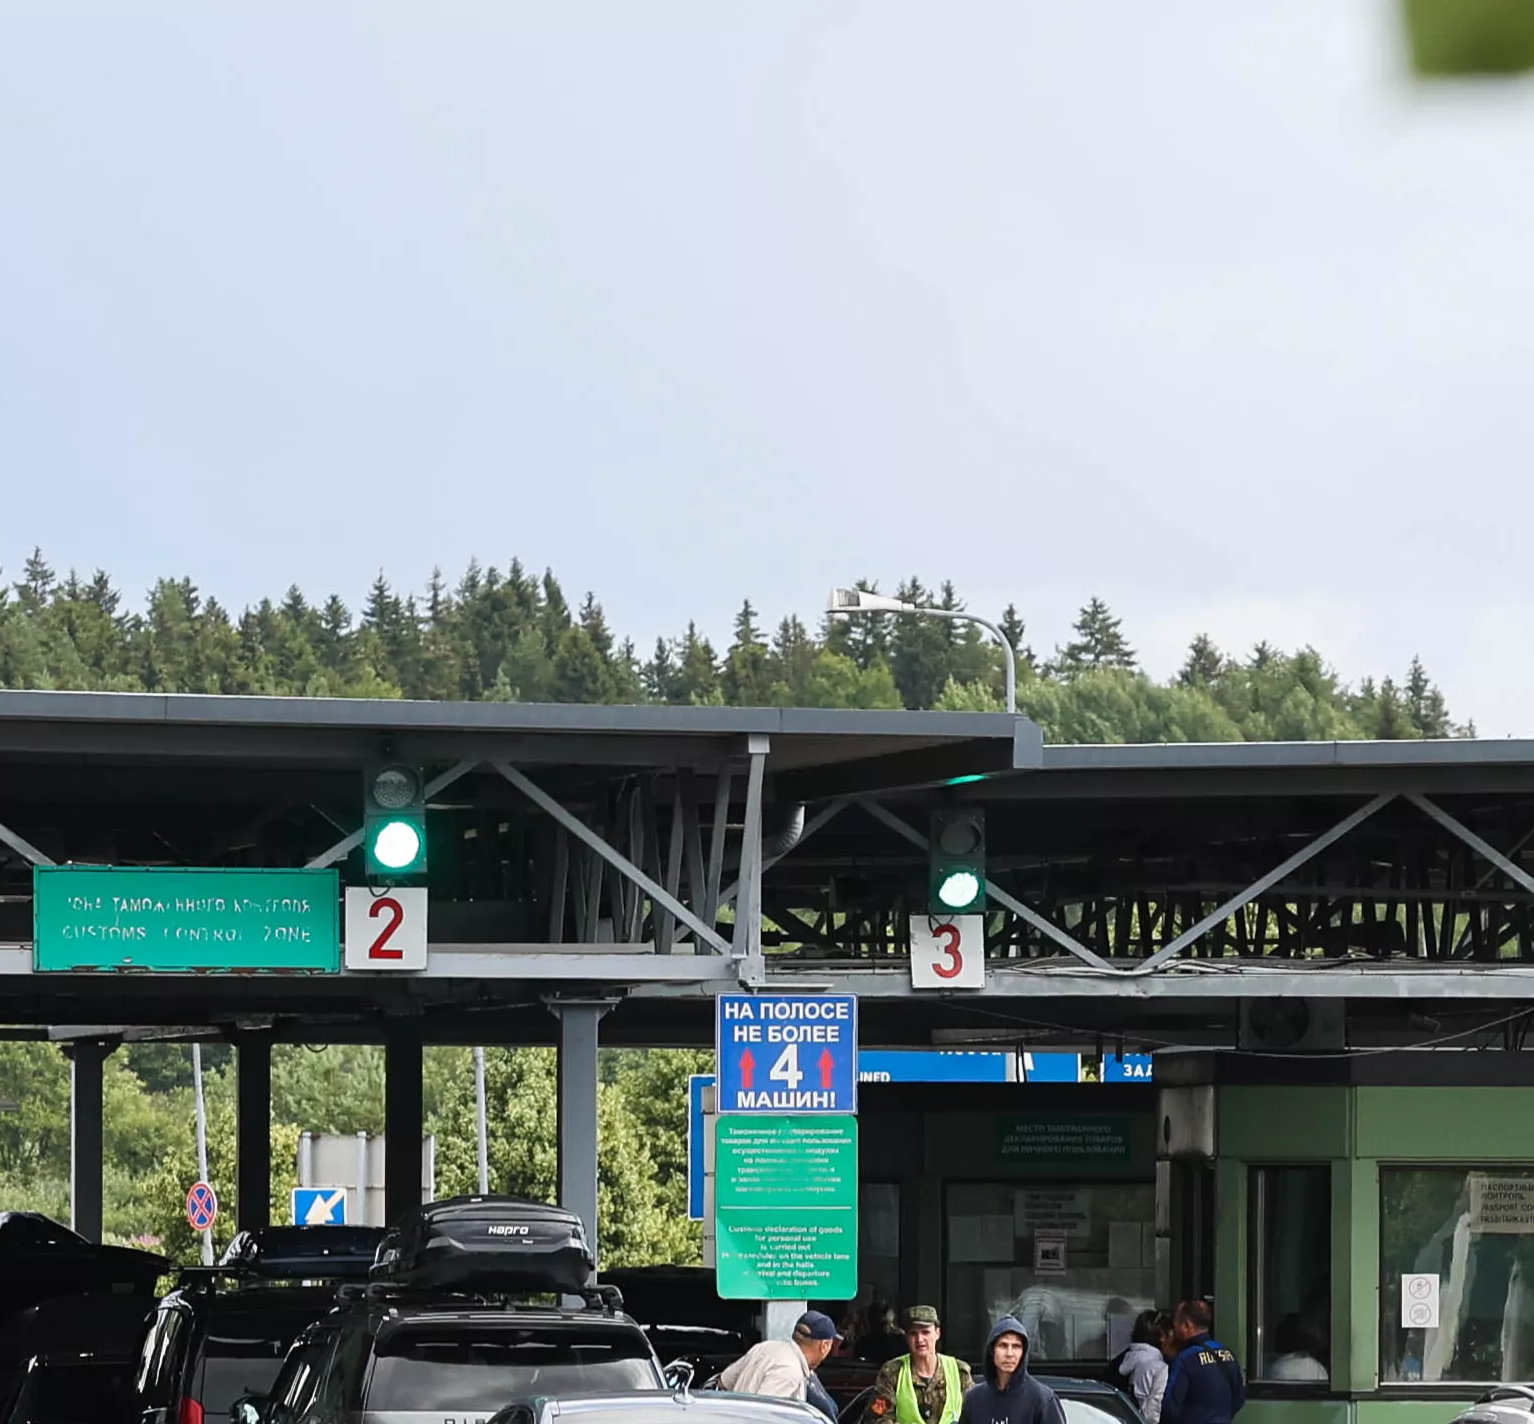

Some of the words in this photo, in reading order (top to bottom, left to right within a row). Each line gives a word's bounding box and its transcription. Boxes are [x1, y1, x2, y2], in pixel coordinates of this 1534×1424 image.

[369, 897, 404, 959] 2
[932, 924, 963, 979] 3
[725, 1002, 755, 1020] НА
[760, 1002, 849, 1020] ПОЛОСЕ
[734, 1025, 762, 1043] НЕ
[768, 1025, 840, 1043] БОЛЕЕ
[769, 1043, 804, 1089] 4
[737, 1091, 836, 1109] МАШИН!
